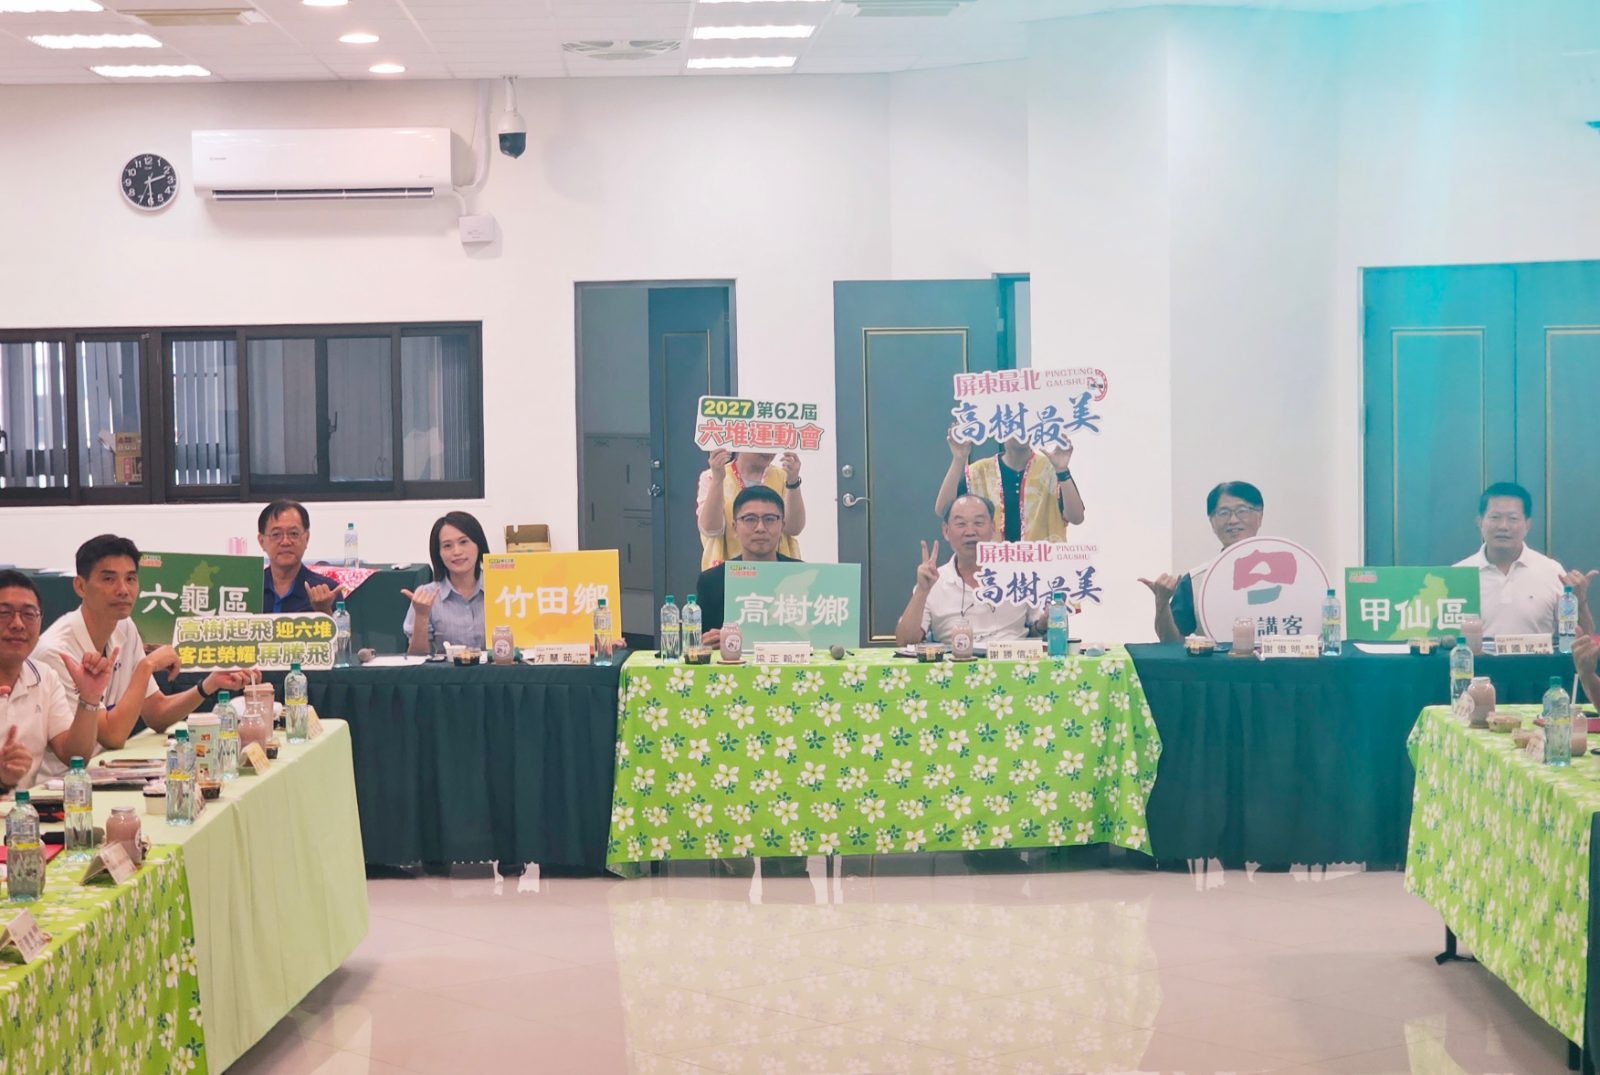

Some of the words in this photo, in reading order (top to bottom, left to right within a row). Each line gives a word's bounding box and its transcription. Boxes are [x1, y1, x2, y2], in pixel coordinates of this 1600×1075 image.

[135, 160, 142, 168] 11
[144, 156, 153, 165] 12
[128, 168, 136, 177] 10
[163, 166, 170, 175] 2
[125, 178, 132, 187] 9
[167, 176, 174, 184] 3
[128, 188, 136, 197] 8
[164, 186, 171, 194] 4
[157, 193, 164, 202] 5
[1045, 367, 1093, 378] PINGTUNG
[955, 370, 1041, 397] 屏東最北
[1046, 377, 1085, 388] GAUSHU
[703, 400, 752, 416] 2027
[757, 401, 817, 421] 第62屆
[954, 391, 1101, 447] 高樹最美
[698, 419, 824, 450] 六堆運動會
[980, 543, 1053, 563] 屏東最北
[1056, 544, 1097, 552] PINGTUNG
[1057, 552, 1090, 560] GAUSHU
[139, 583, 254, 617] 六龜區
[495, 583, 609, 618] 竹田鄉
[735, 592, 849, 627] 高樹鄉
[1360, 598, 1467, 631] 甲仙區
[178, 617, 273, 641] 高樹起飛
[275, 621, 332, 638] 迎六堆
[1257, 615, 1302, 636] 講客
[178, 645, 256, 664] 客庄榮耀
[258, 641, 330, 665] 再騰飛
